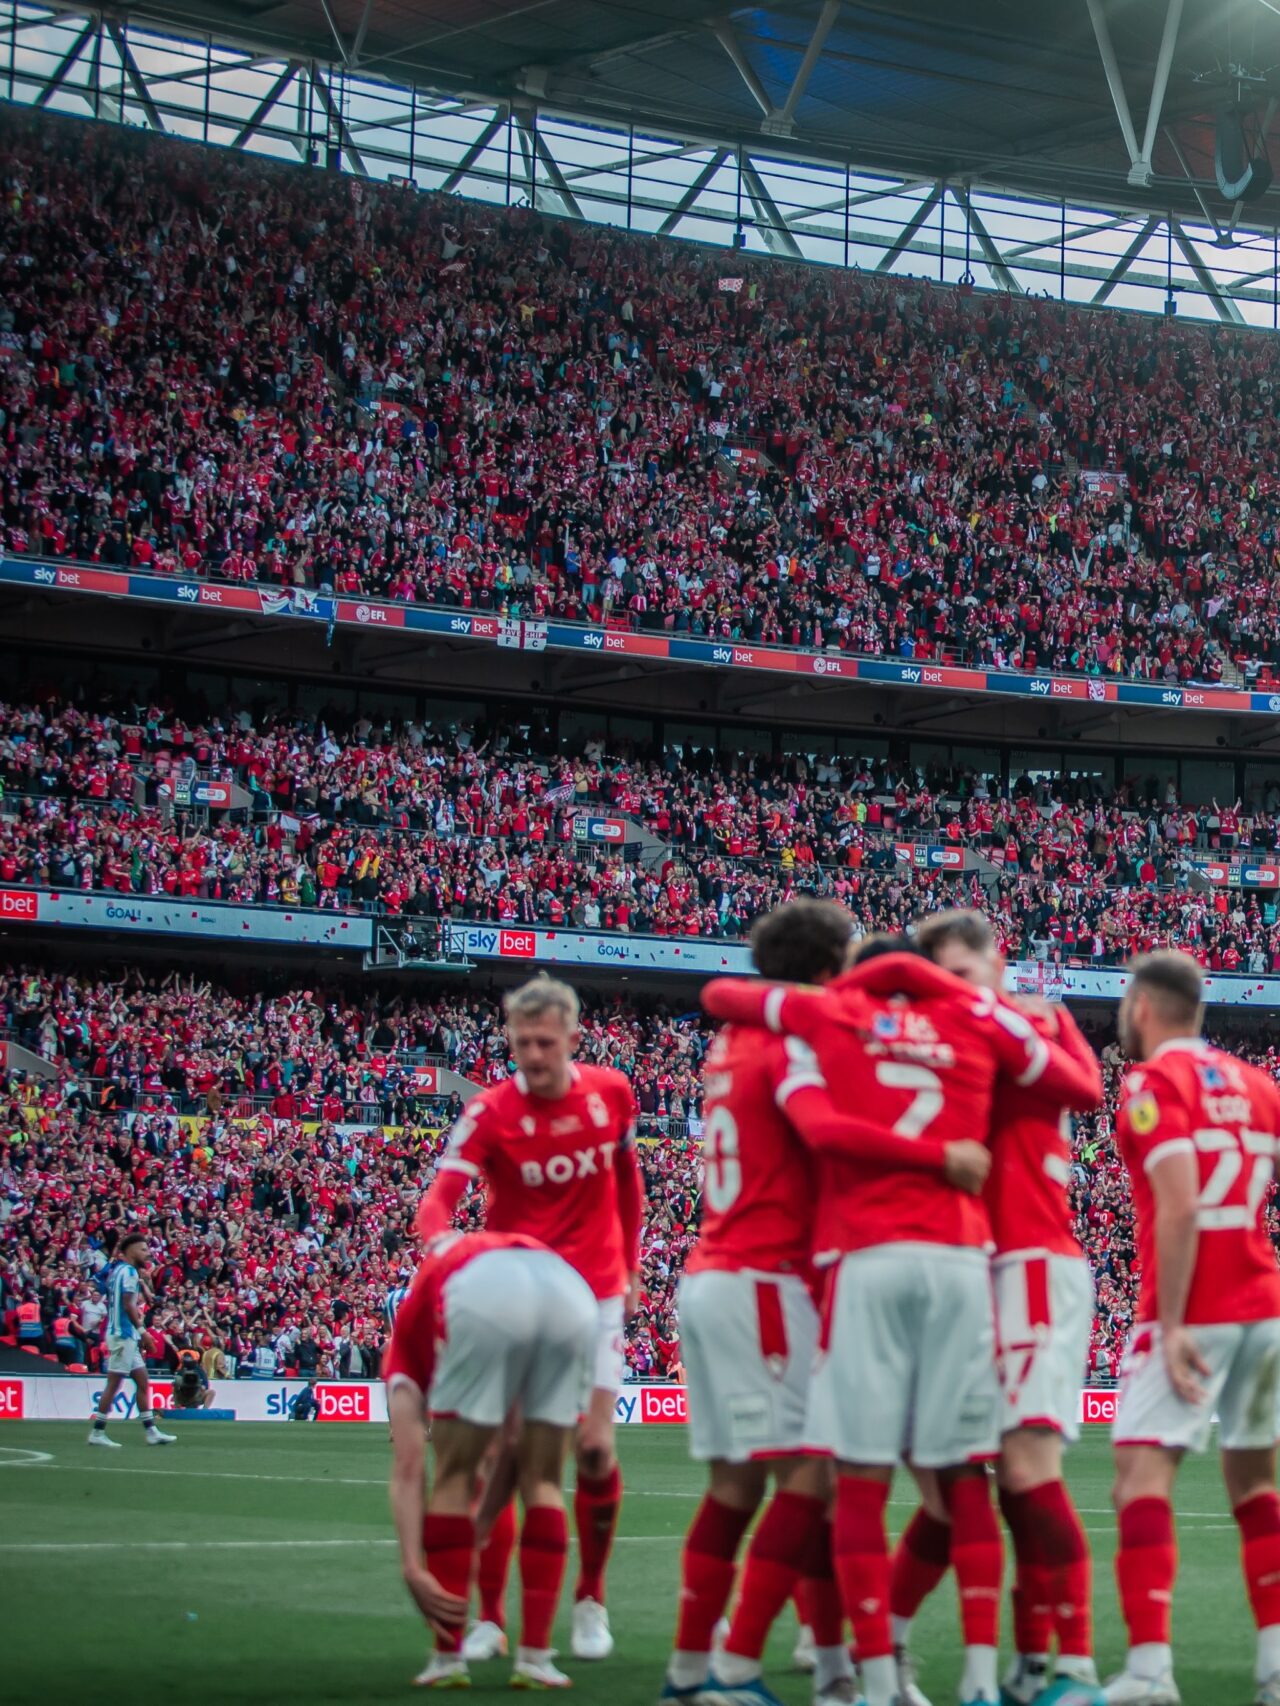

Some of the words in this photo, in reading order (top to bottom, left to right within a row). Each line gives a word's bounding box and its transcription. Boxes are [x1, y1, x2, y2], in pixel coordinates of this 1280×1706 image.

[34, 567, 56, 582] sky
[59, 570, 80, 584] bet
[177, 586, 198, 600] sky
[202, 588, 222, 601] bet
[370, 610, 387, 621] EFL
[451, 618, 471, 633] sky
[474, 621, 493, 634] bet
[505, 637, 511, 645] F
[583, 633, 602, 648] sky
[605, 635, 625, 648] bet
[713, 647, 732, 663] sky
[735, 649, 753, 663] bet
[826, 661, 842, 672] EFL
[901, 667, 920, 682] sky
[924, 669, 943, 682] bet
[1030, 680, 1049, 695] sky
[1053, 682, 1072, 694] bet
[1162, 691, 1181, 705] sky
[1185, 693, 1204, 704] bet
[3, 894, 34, 913] bet
[106, 907, 141, 919] GOAL!
[468, 931, 497, 952] sky
[503, 933, 532, 951] bet
[597, 944, 629, 956] GOAL!
[875, 1060, 945, 1139] 7
[520, 1142, 617, 1187] BOXT
[1192, 1127, 1276, 1231] 27
[266, 1387, 297, 1415] sk
[321, 1389, 364, 1415] bet
[646, 1392, 686, 1416] bet
